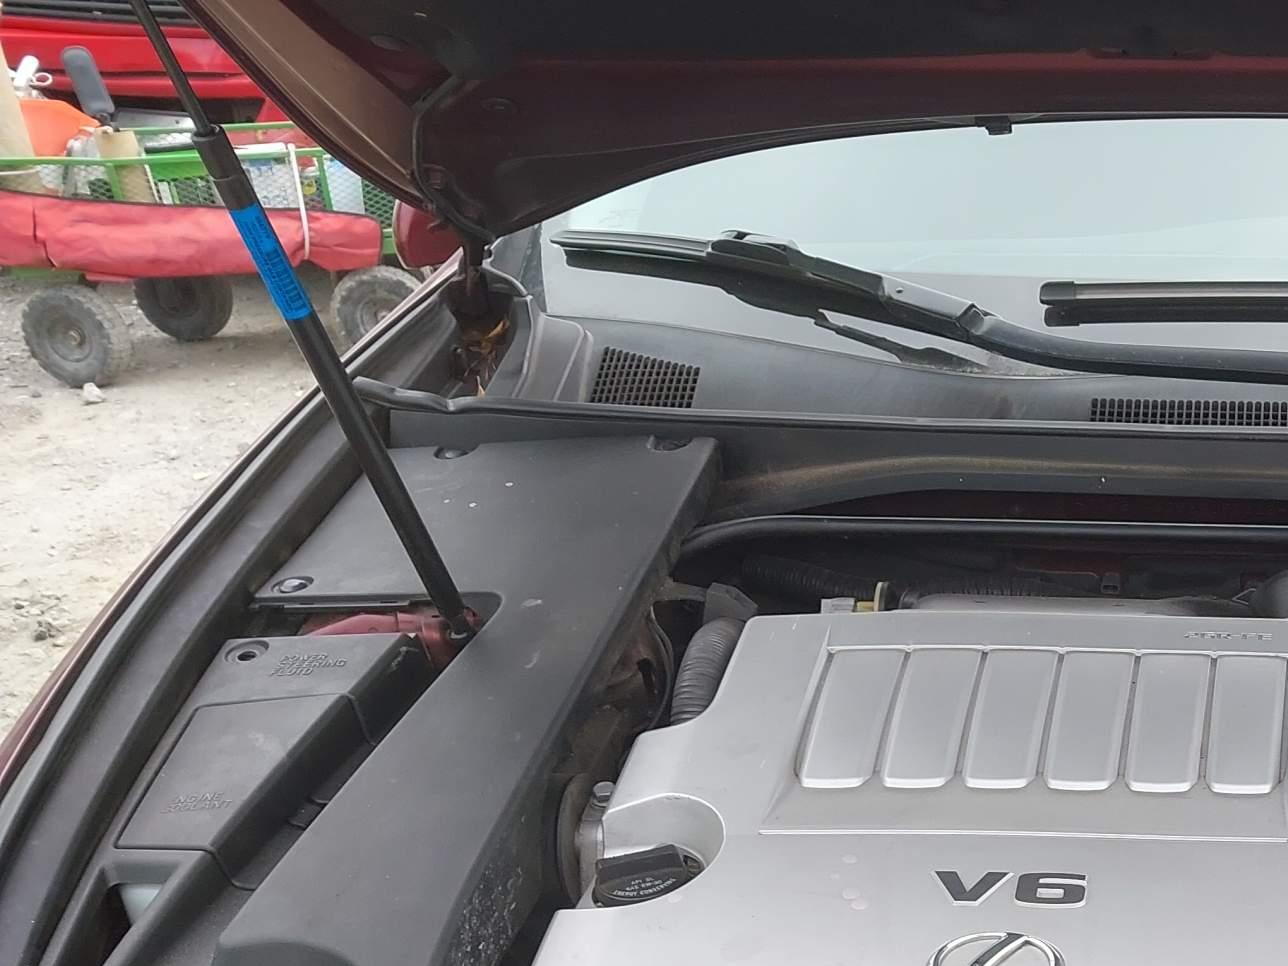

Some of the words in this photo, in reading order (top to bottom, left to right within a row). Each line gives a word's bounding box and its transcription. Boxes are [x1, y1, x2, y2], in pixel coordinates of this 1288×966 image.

[280, 652, 328, 662] POWER
[278, 657, 348, 669] STEERING
[270, 666, 314, 677] FLUID
[932, 870, 1089, 909] V6
